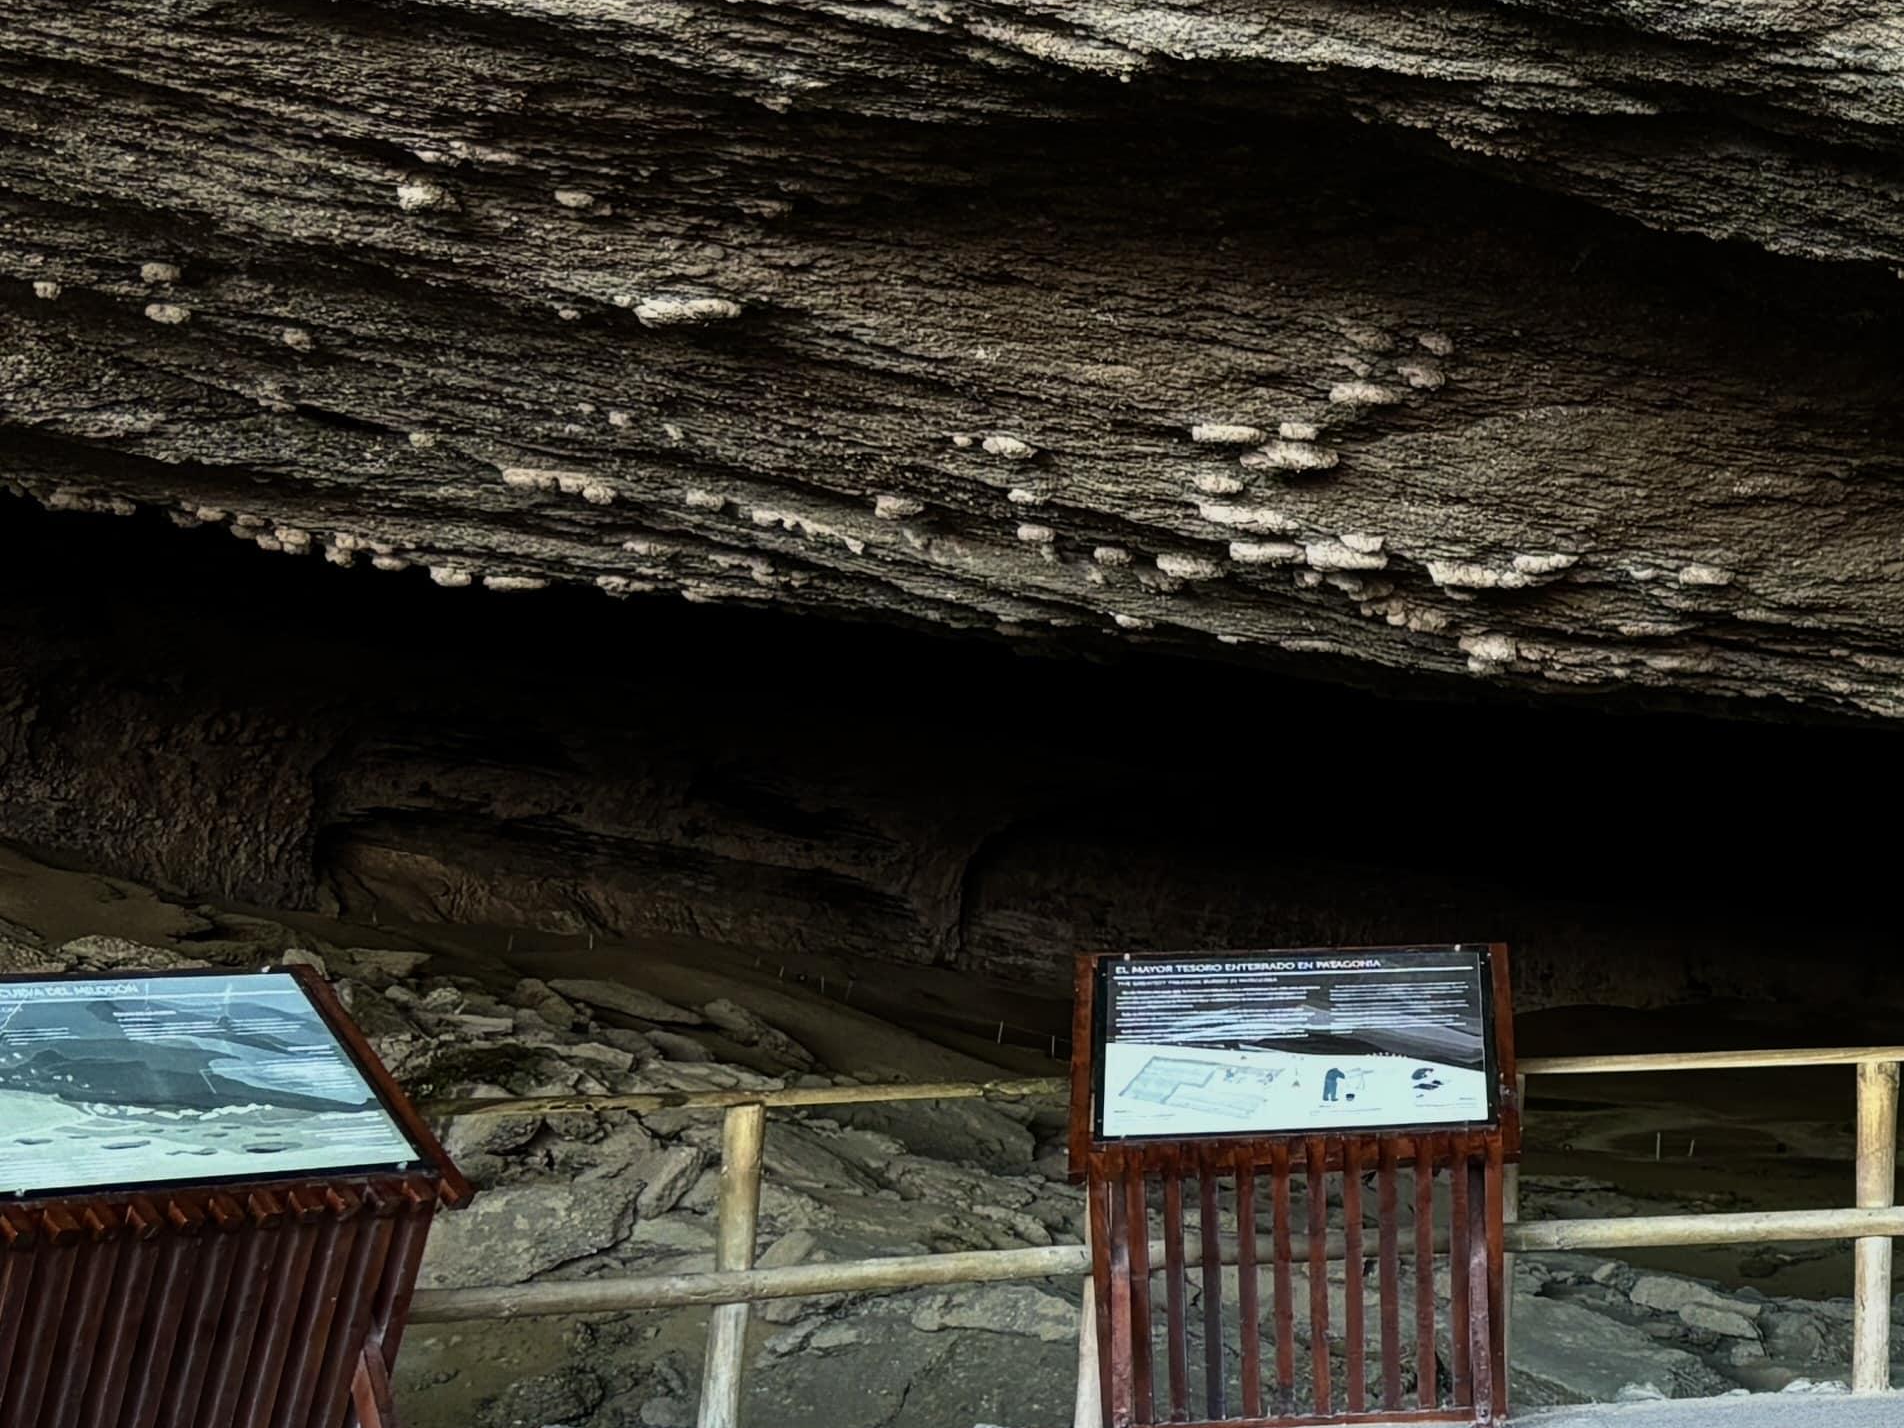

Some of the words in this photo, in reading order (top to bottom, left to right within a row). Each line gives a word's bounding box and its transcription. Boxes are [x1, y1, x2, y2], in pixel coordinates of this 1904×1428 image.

[1116, 966, 1129, 974] EL
[1132, 965, 1173, 973] MAYOR
[1176, 964, 1222, 972] TESORO
[1225, 962, 1295, 971] ENTERRADO
[1297, 961, 1313, 969] EN
[1316, 959, 1381, 969] PATAGONIA
